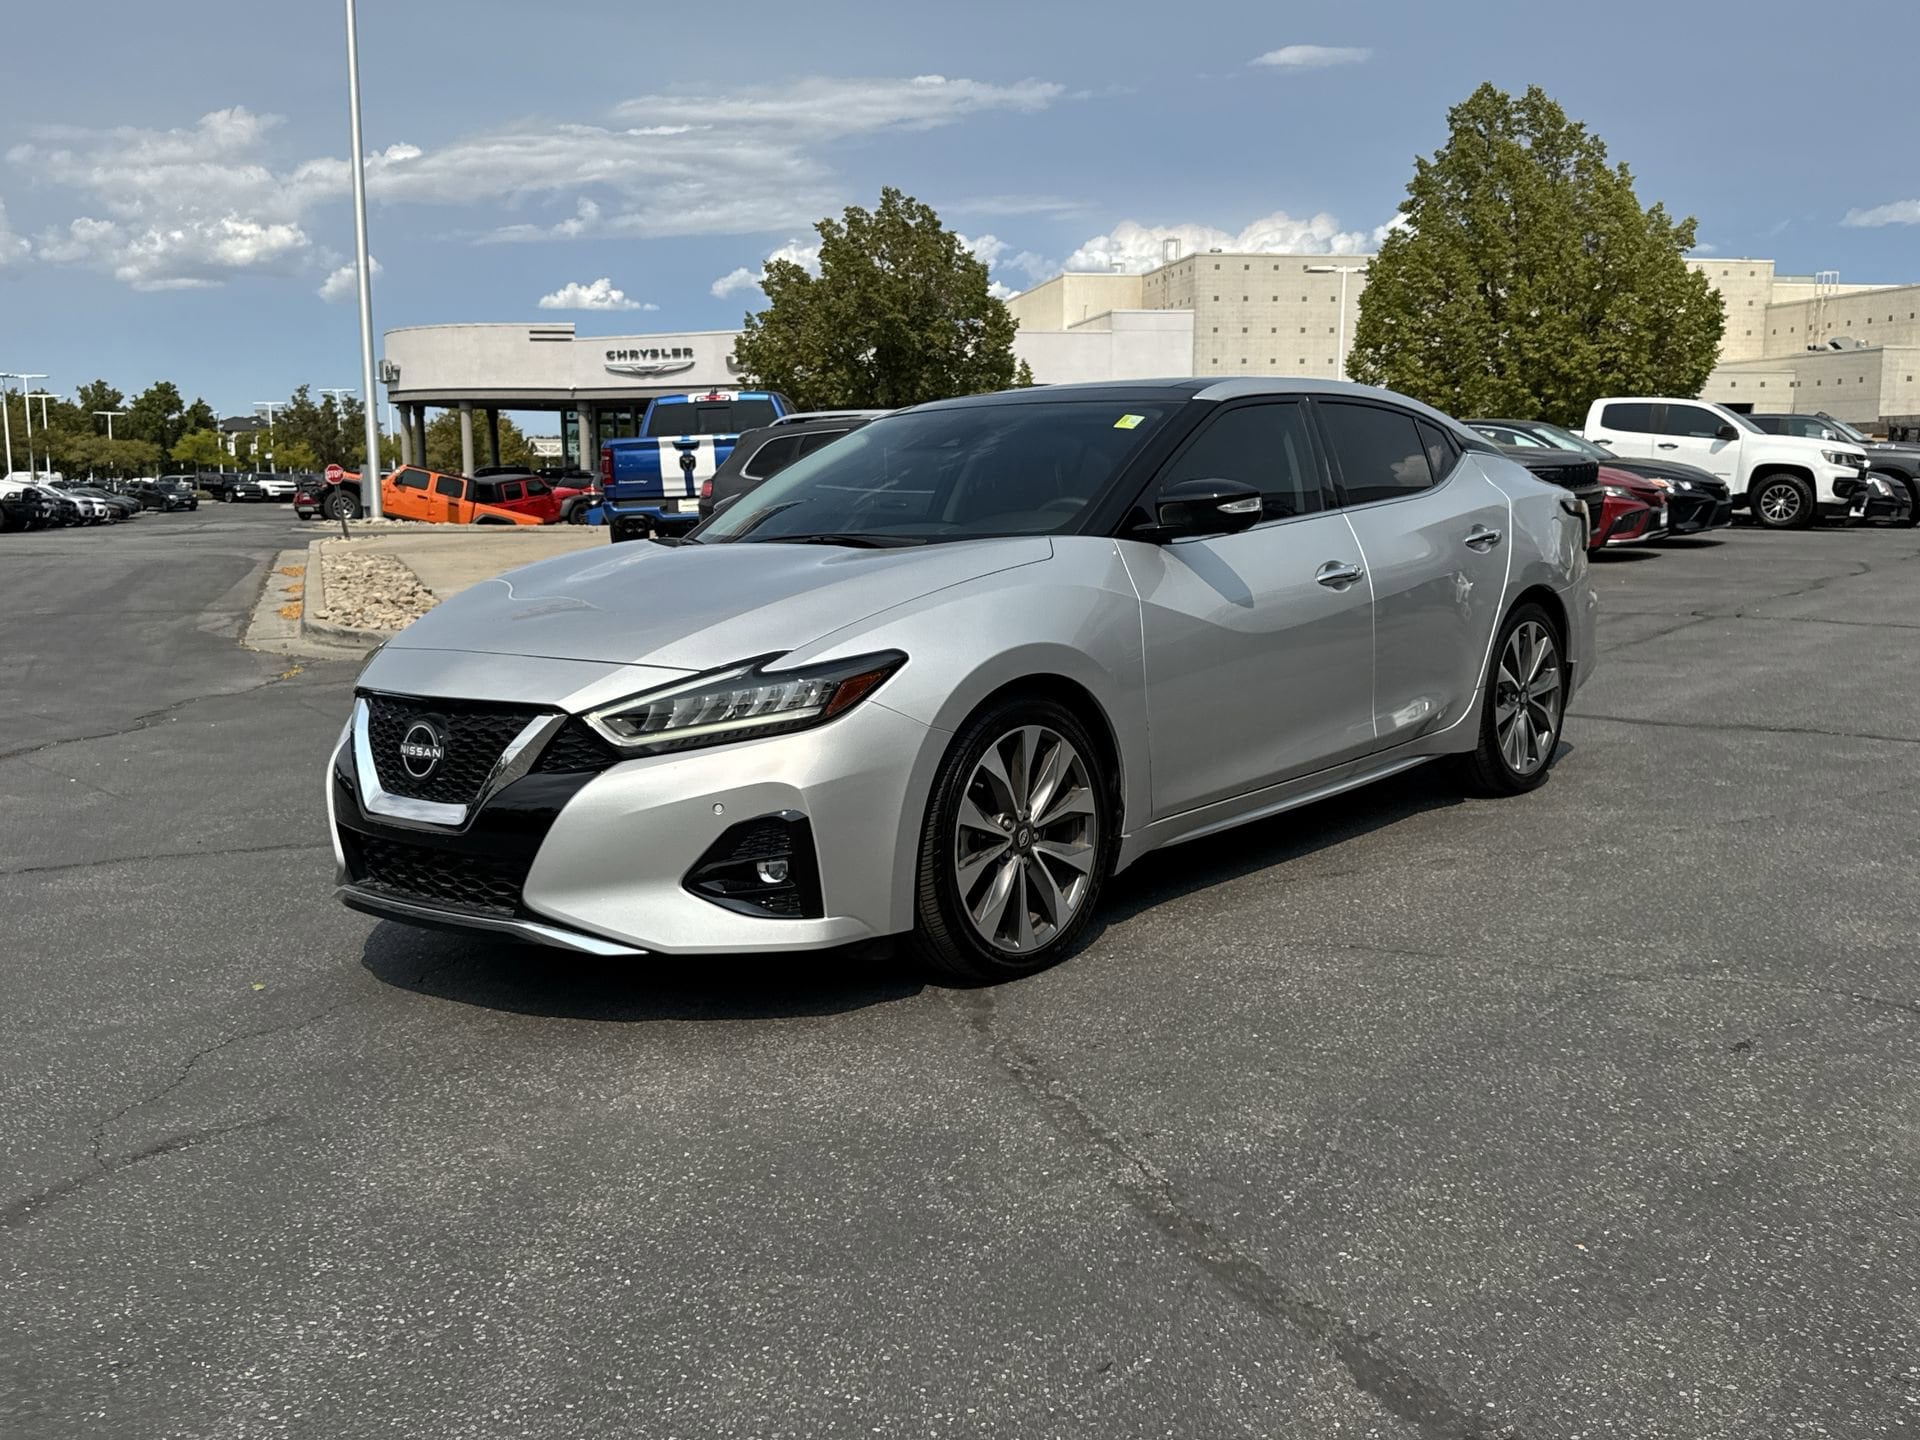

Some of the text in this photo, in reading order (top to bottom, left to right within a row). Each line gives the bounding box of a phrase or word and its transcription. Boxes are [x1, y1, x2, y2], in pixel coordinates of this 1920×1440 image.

[606, 347, 694, 361] CHRYSLER
[326, 469, 342, 478] STOP
[400, 744, 441, 758] NISSAN
